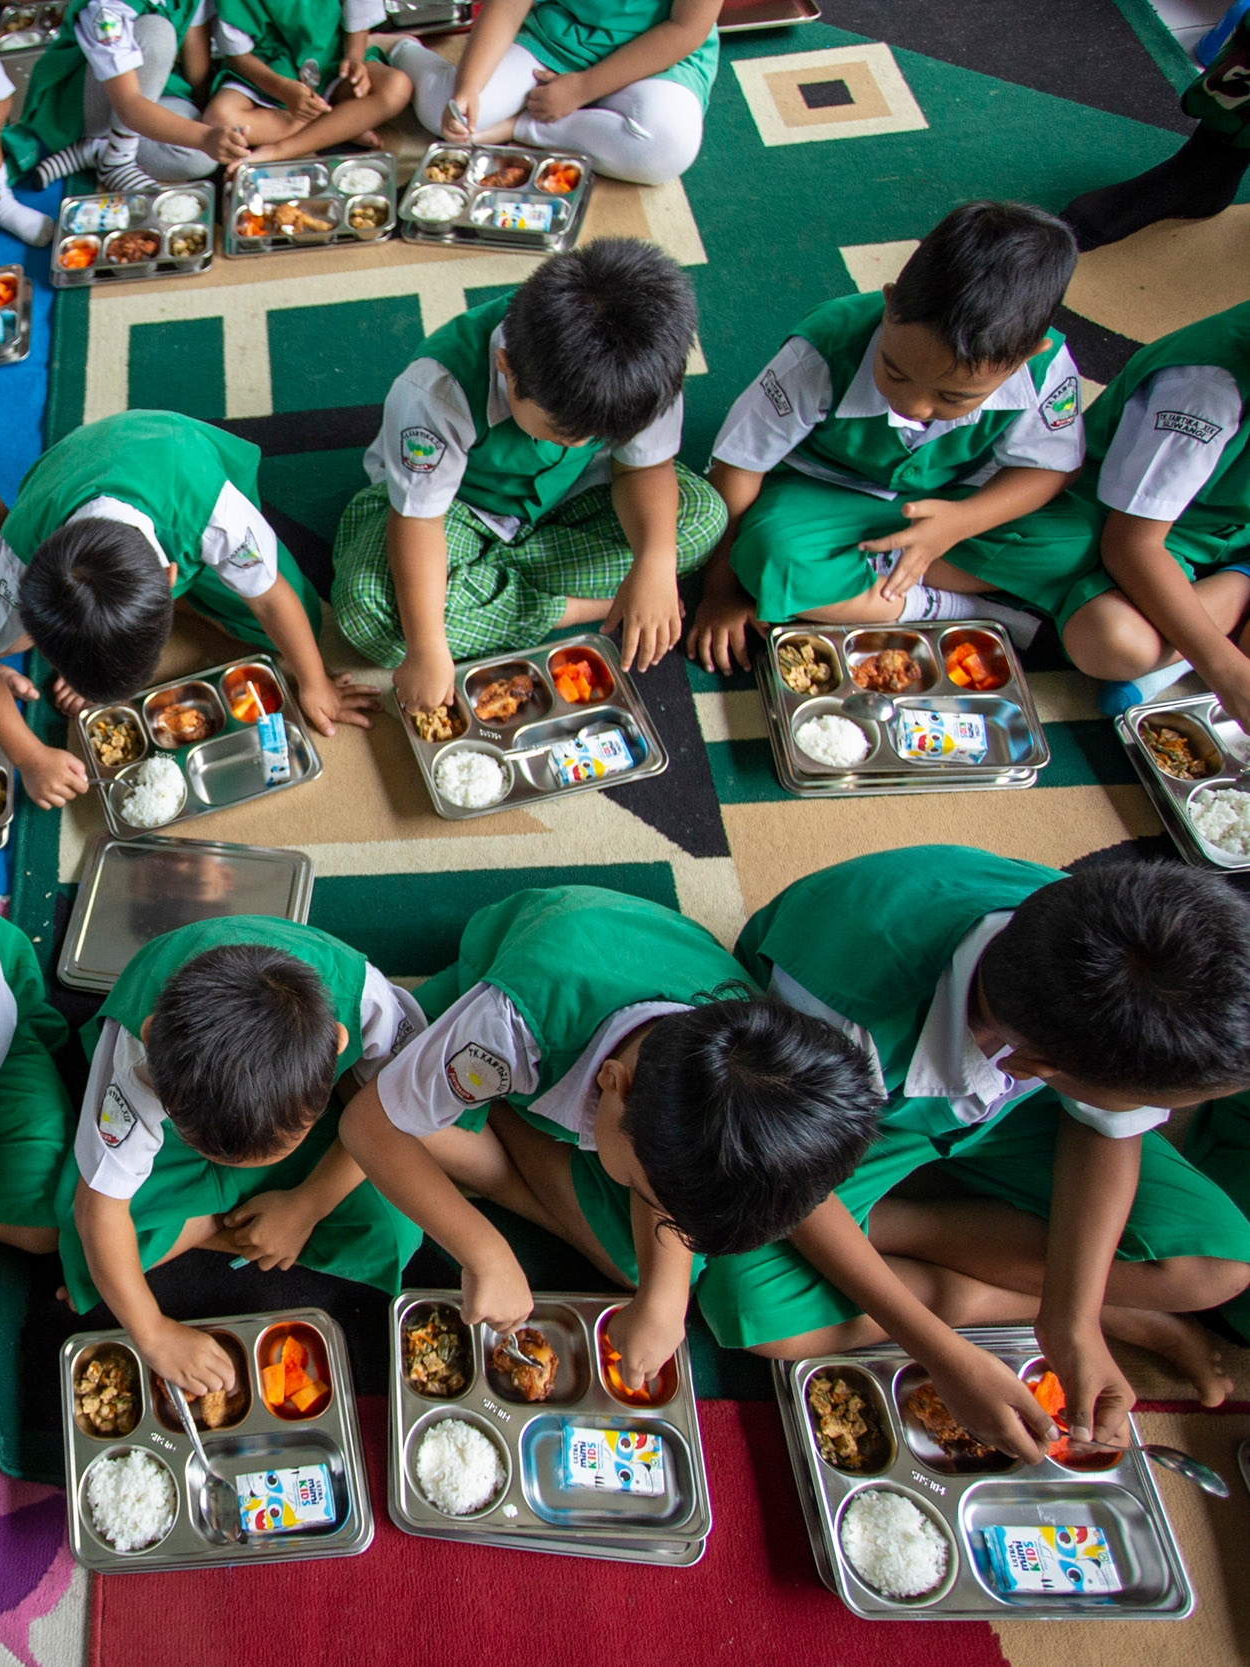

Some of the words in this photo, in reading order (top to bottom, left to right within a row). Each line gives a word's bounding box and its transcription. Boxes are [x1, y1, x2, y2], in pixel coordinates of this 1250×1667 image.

[578, 1440, 587, 1469] mimi
[587, 1442, 597, 1470] KIDS
[299, 1480, 311, 1507] KIDS
[308, 1478, 320, 1505] mimi
[1008, 1544, 1019, 1568] ULTRA
[1012, 1540, 1030, 1571] mimi
[1023, 1541, 1041, 1572] KIDS
